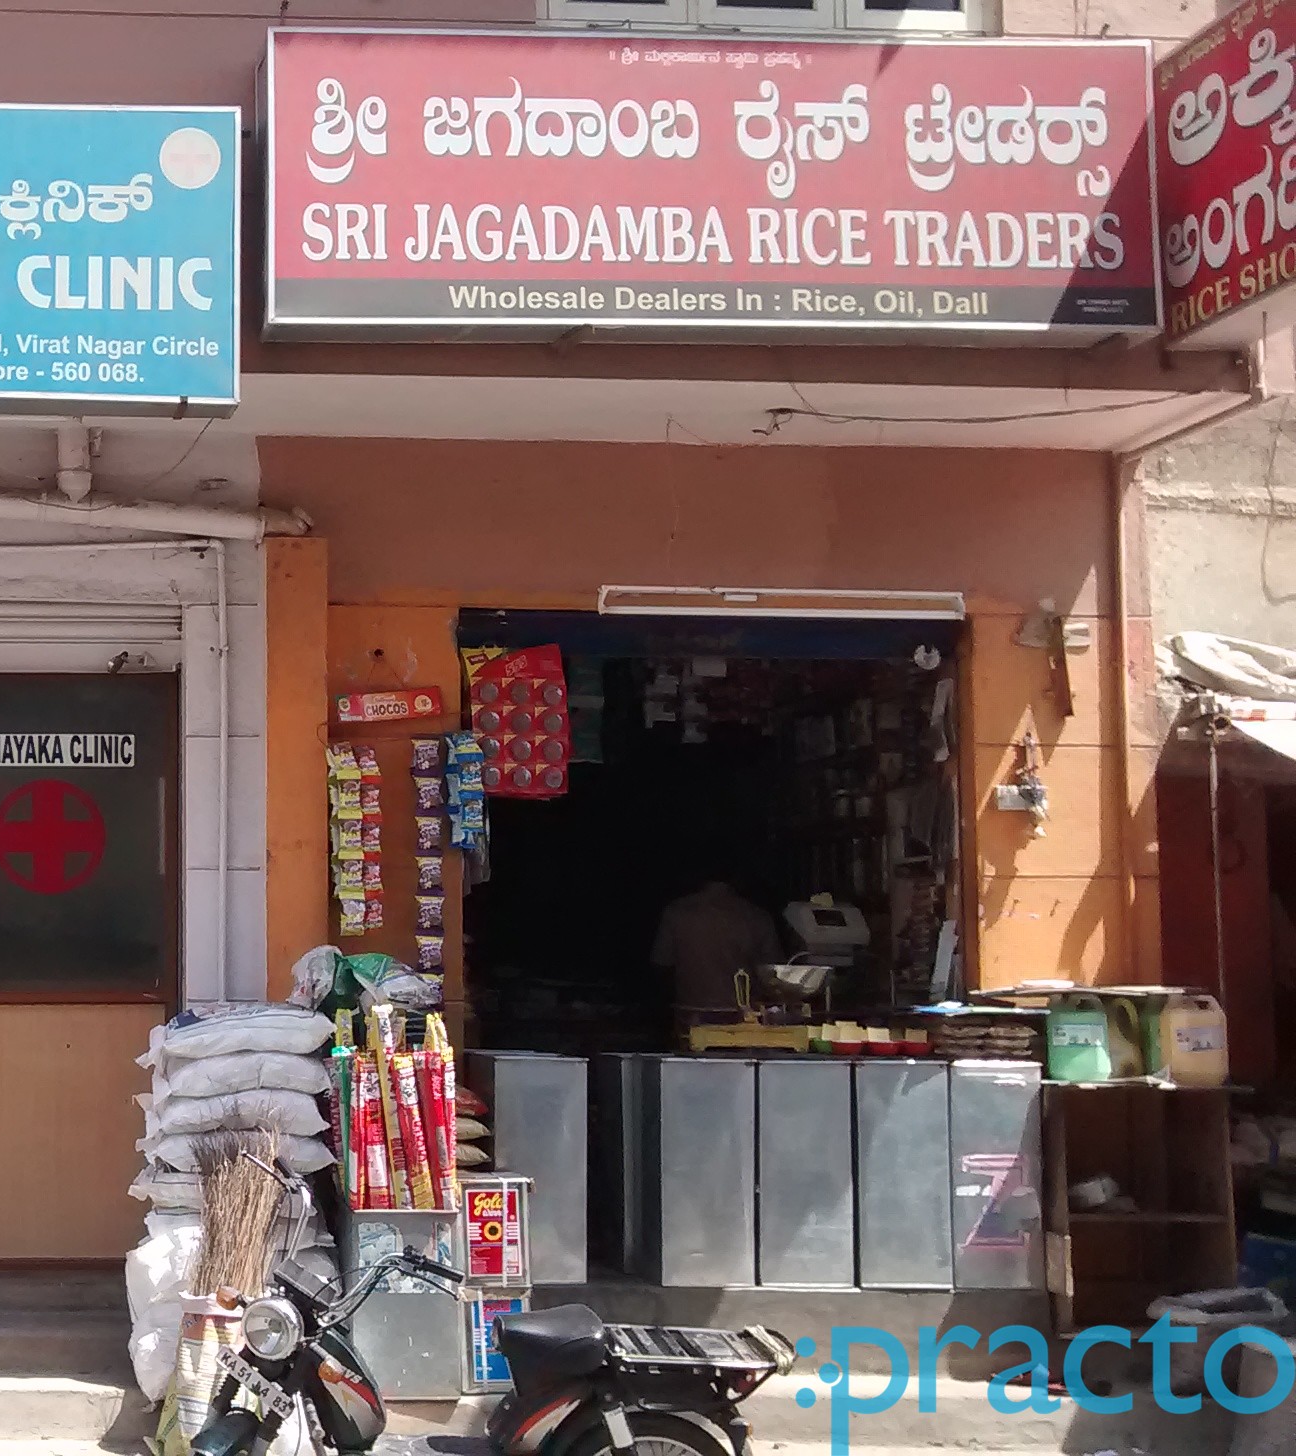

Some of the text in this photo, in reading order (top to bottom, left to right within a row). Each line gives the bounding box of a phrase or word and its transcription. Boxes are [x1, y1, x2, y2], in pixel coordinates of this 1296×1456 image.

[306, 77, 388, 184] ಶ್ರೀ
[423, 76, 700, 159] ಜಗದಾಂಬ
[734, 79, 870, 199] ರೈಸ್
[301, 202, 1124, 271] SRI JAGADAMBA RICE TRADERS
[16, 255, 214, 311] CLINIC
[448, 285, 605, 311] Wholesale
[615, 286, 726, 312] Dealers
[736, 289, 763, 311] In
[791, 290, 865, 317] Rice,
[874, 290, 924, 317] Oil,
[933, 291, 988, 316] Dall
[1171, 276, 1232, 334] RICE
[16, 335, 70, 355] Virat
[77, 337, 145, 360] Nagar
[152, 337, 219, 358] Circle
[51, 362, 91, 381] 560
[98, 363, 144, 383] 068.
[366, 702, 408, 716] CHOCOS
[70, 735, 132, 764] CLINIC
[221, 1352, 237, 1371] KA
[237, 1367, 252, 1381] 51
